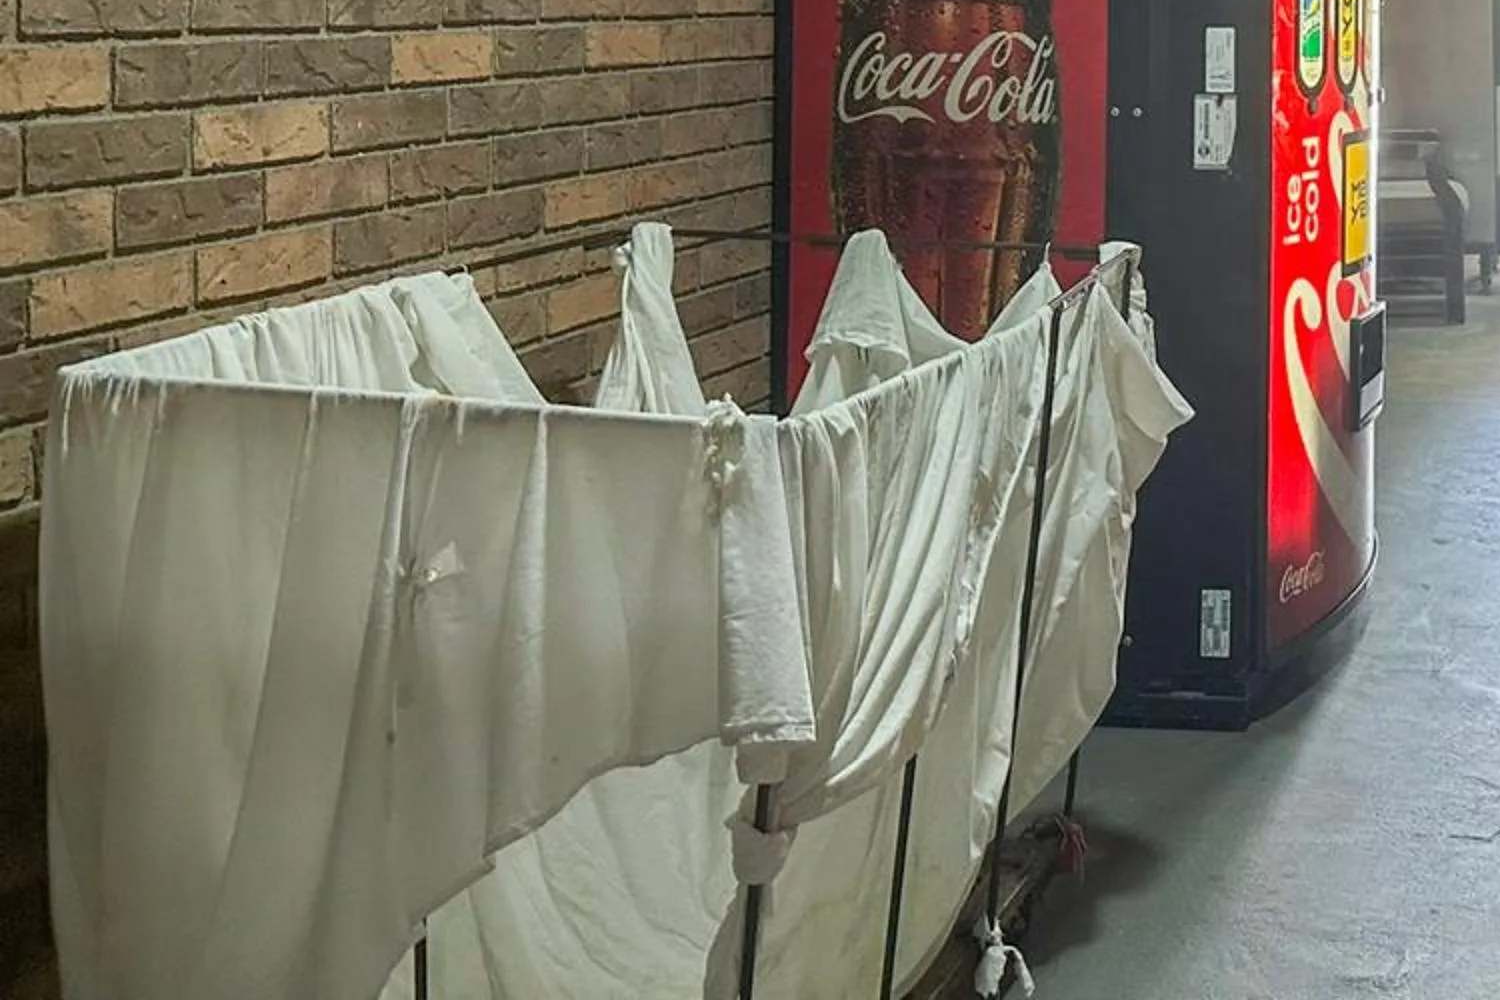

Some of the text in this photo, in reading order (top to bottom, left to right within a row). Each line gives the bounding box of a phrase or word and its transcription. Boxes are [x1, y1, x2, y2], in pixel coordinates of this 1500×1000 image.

[838, 31, 1056, 124] Coca-Cola
[1283, 174, 1302, 246] Ice
[1302, 136, 1320, 243] cold
